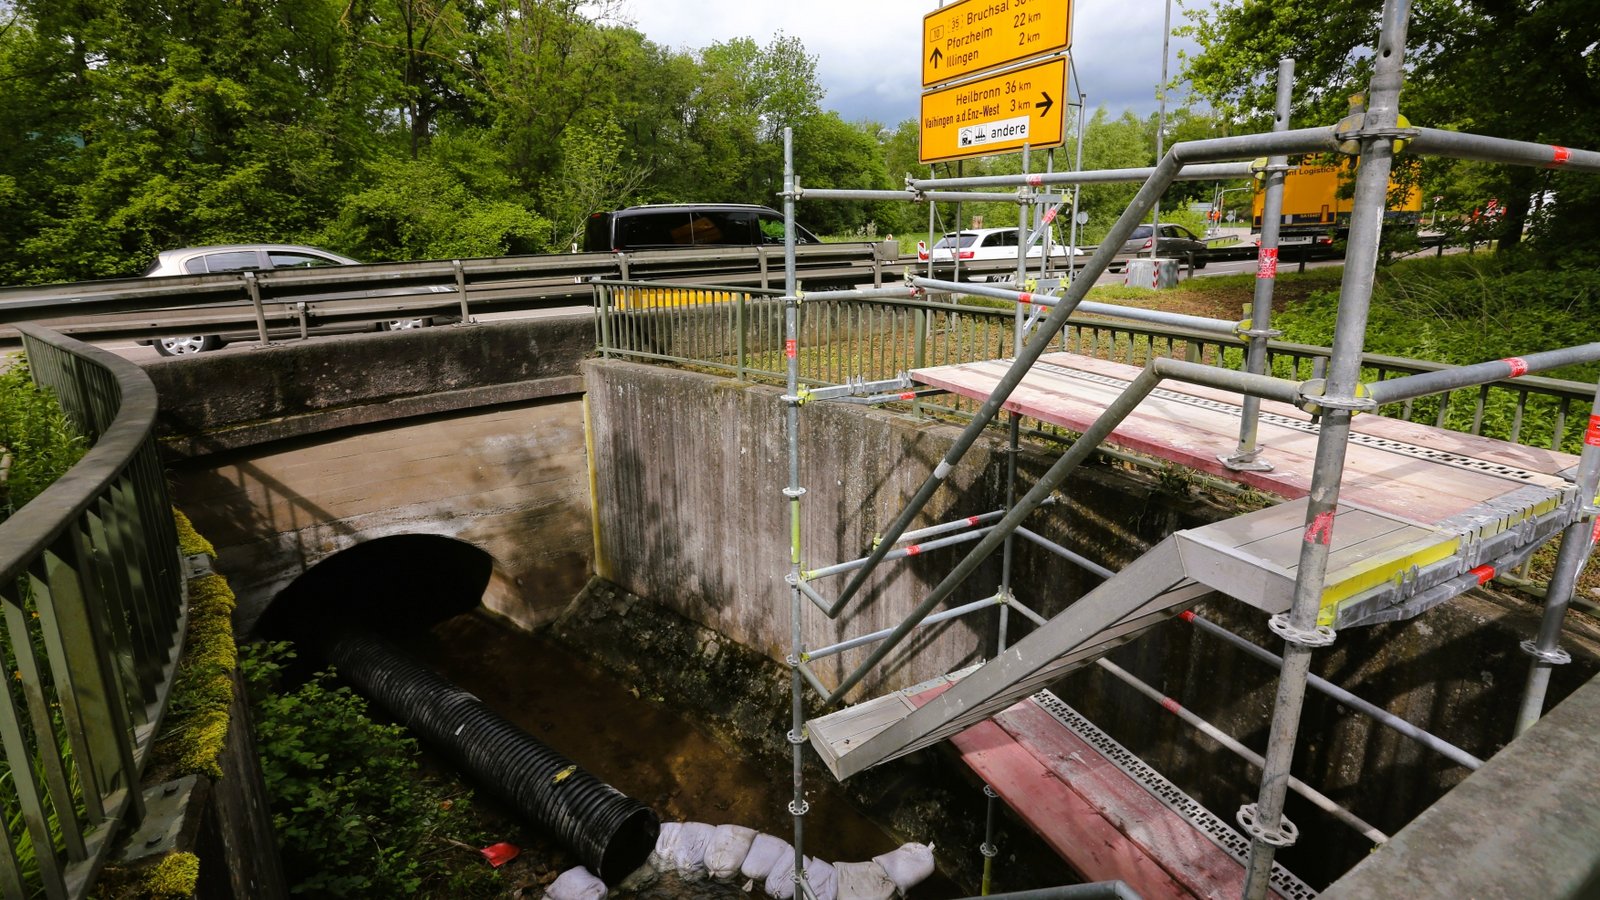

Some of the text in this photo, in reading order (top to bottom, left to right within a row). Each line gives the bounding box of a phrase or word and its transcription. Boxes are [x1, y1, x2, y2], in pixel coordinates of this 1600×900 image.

[967, 0, 1009, 25] Bruchsal
[947, 12, 1041, 50] Pforzheim 22 km
[946, 32, 1040, 68] Illingen 2 km
[956, 80, 1032, 106] Heilbronn 36 km
[924, 115, 954, 129] Vaihingen
[1010, 99, 1016, 112] 3
[1017, 101, 1031, 110] km
[991, 124, 1026, 139] andere
[1299, 167, 1336, 176] Logistics
